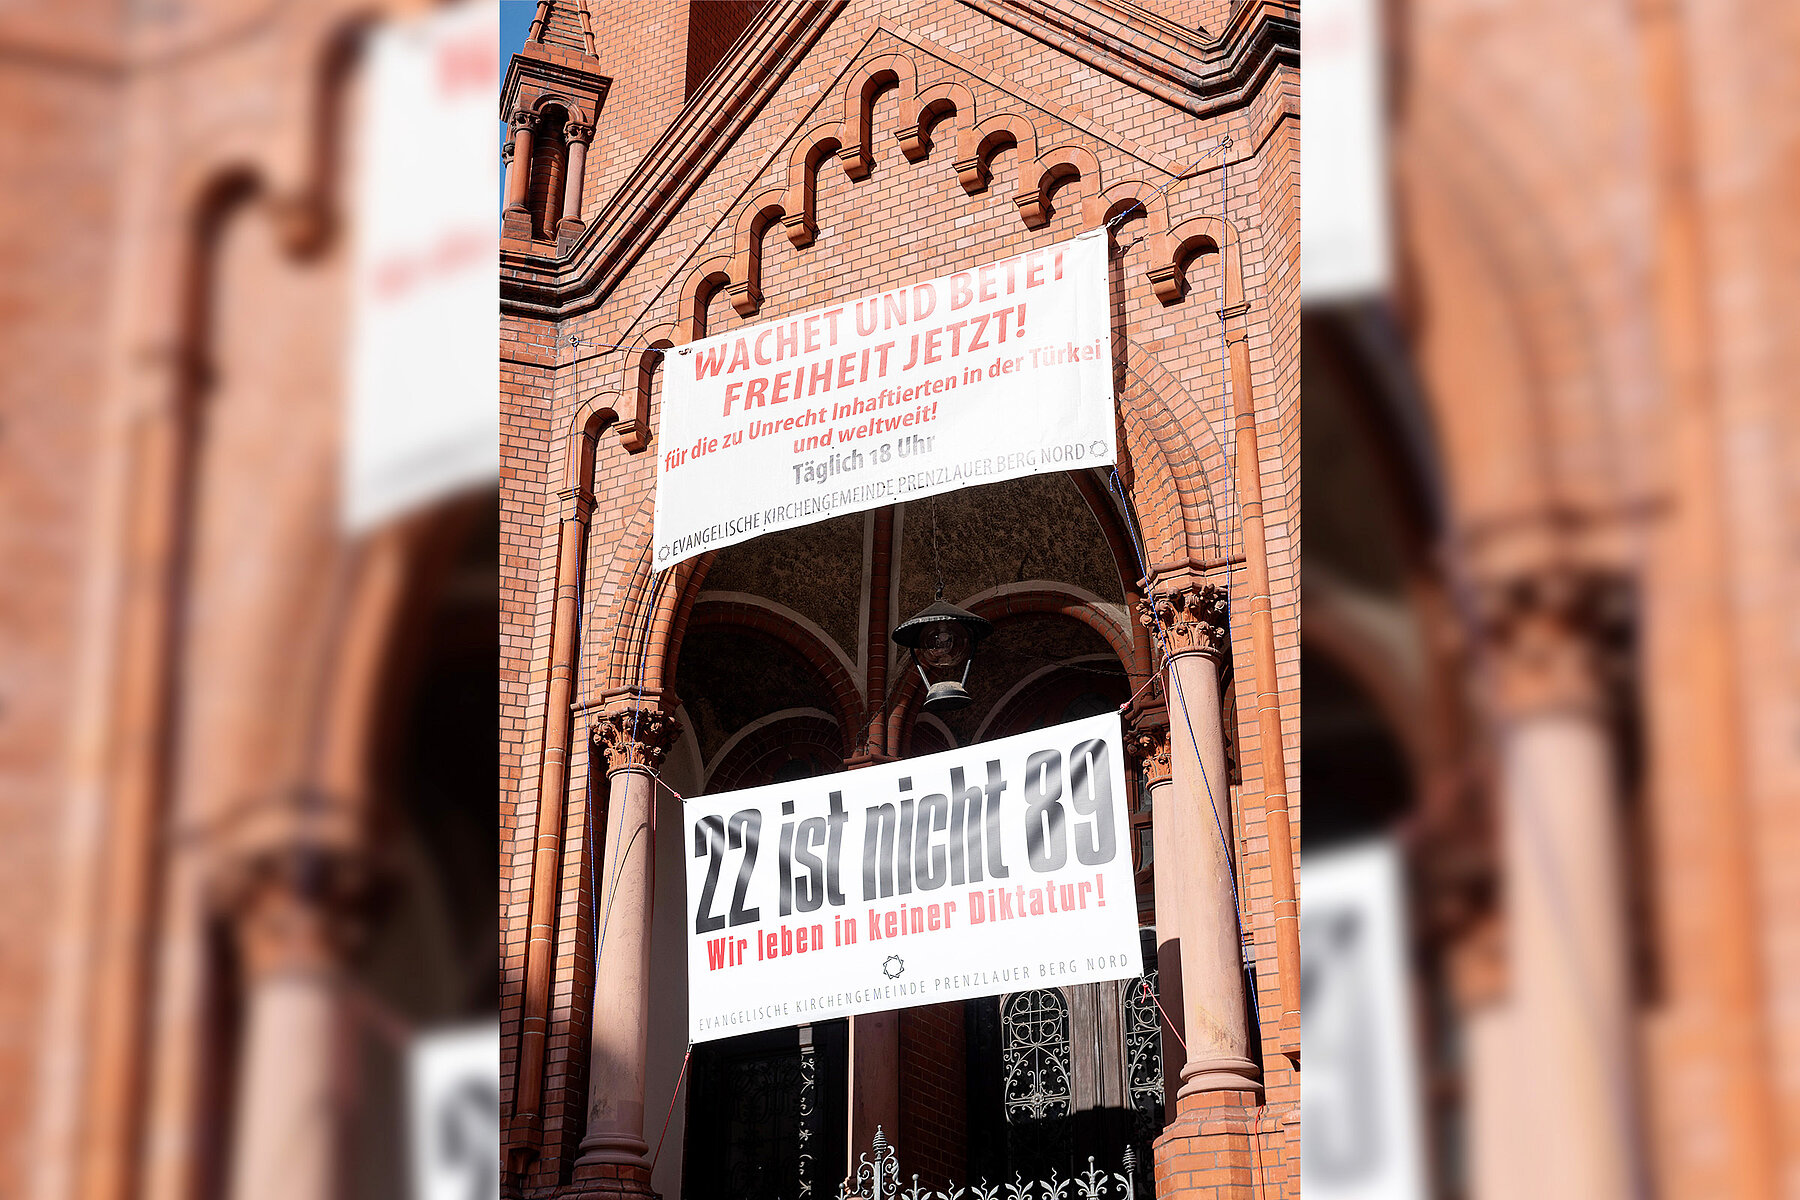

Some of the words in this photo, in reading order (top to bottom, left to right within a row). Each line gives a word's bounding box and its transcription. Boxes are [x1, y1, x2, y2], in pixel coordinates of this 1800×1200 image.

[695, 308, 843, 381] WACHET
[856, 284, 936, 336] UND
[950, 243, 1071, 311] BETET
[723, 341, 895, 416] FREIHEIT
[903, 303, 1027, 371] JETZT!
[664, 447, 689, 472] für
[691, 427, 718, 459] die
[722, 431, 743, 447] zu
[749, 405, 827, 440] Unrecht
[831, 375, 957, 422] Inhaftierten
[963, 367, 982, 386] in
[989, 357, 1023, 378] der
[1029, 339, 1101, 369] Türkei
[792, 455, 863, 486] Täglich
[869, 444, 891, 463] 18
[898, 433, 936, 460] Uhr
[793, 427, 832, 454] und
[838, 403, 938, 445] weltweit!
[672, 512, 760, 556] EVANGELISCHE
[764, 483, 894, 525] KIRCHENGEMEINDE
[898, 460, 992, 492] PRENZLAUER
[997, 449, 1035, 472] BERG
[1040, 444, 1085, 464] NORD
[694, 808, 762, 934] 22
[779, 790, 848, 917] ist
[862, 760, 1009, 901] nicht
[1024, 738, 1117, 873] 89
[707, 937, 747, 971] Wir
[758, 925, 823, 962] leben
[835, 915, 857, 947] in
[869, 902, 956, 942] keiner
[969, 874, 1106, 925] Diktatur!
[699, 1003, 789, 1031] EVANGELISCHE
[796, 980, 926, 1012] KIRCHENGEMEINDE
[935, 965, 1030, 991] PRENZLAUER
[1039, 960, 1077, 977] BERG
[1086, 953, 1128, 970] NORD
